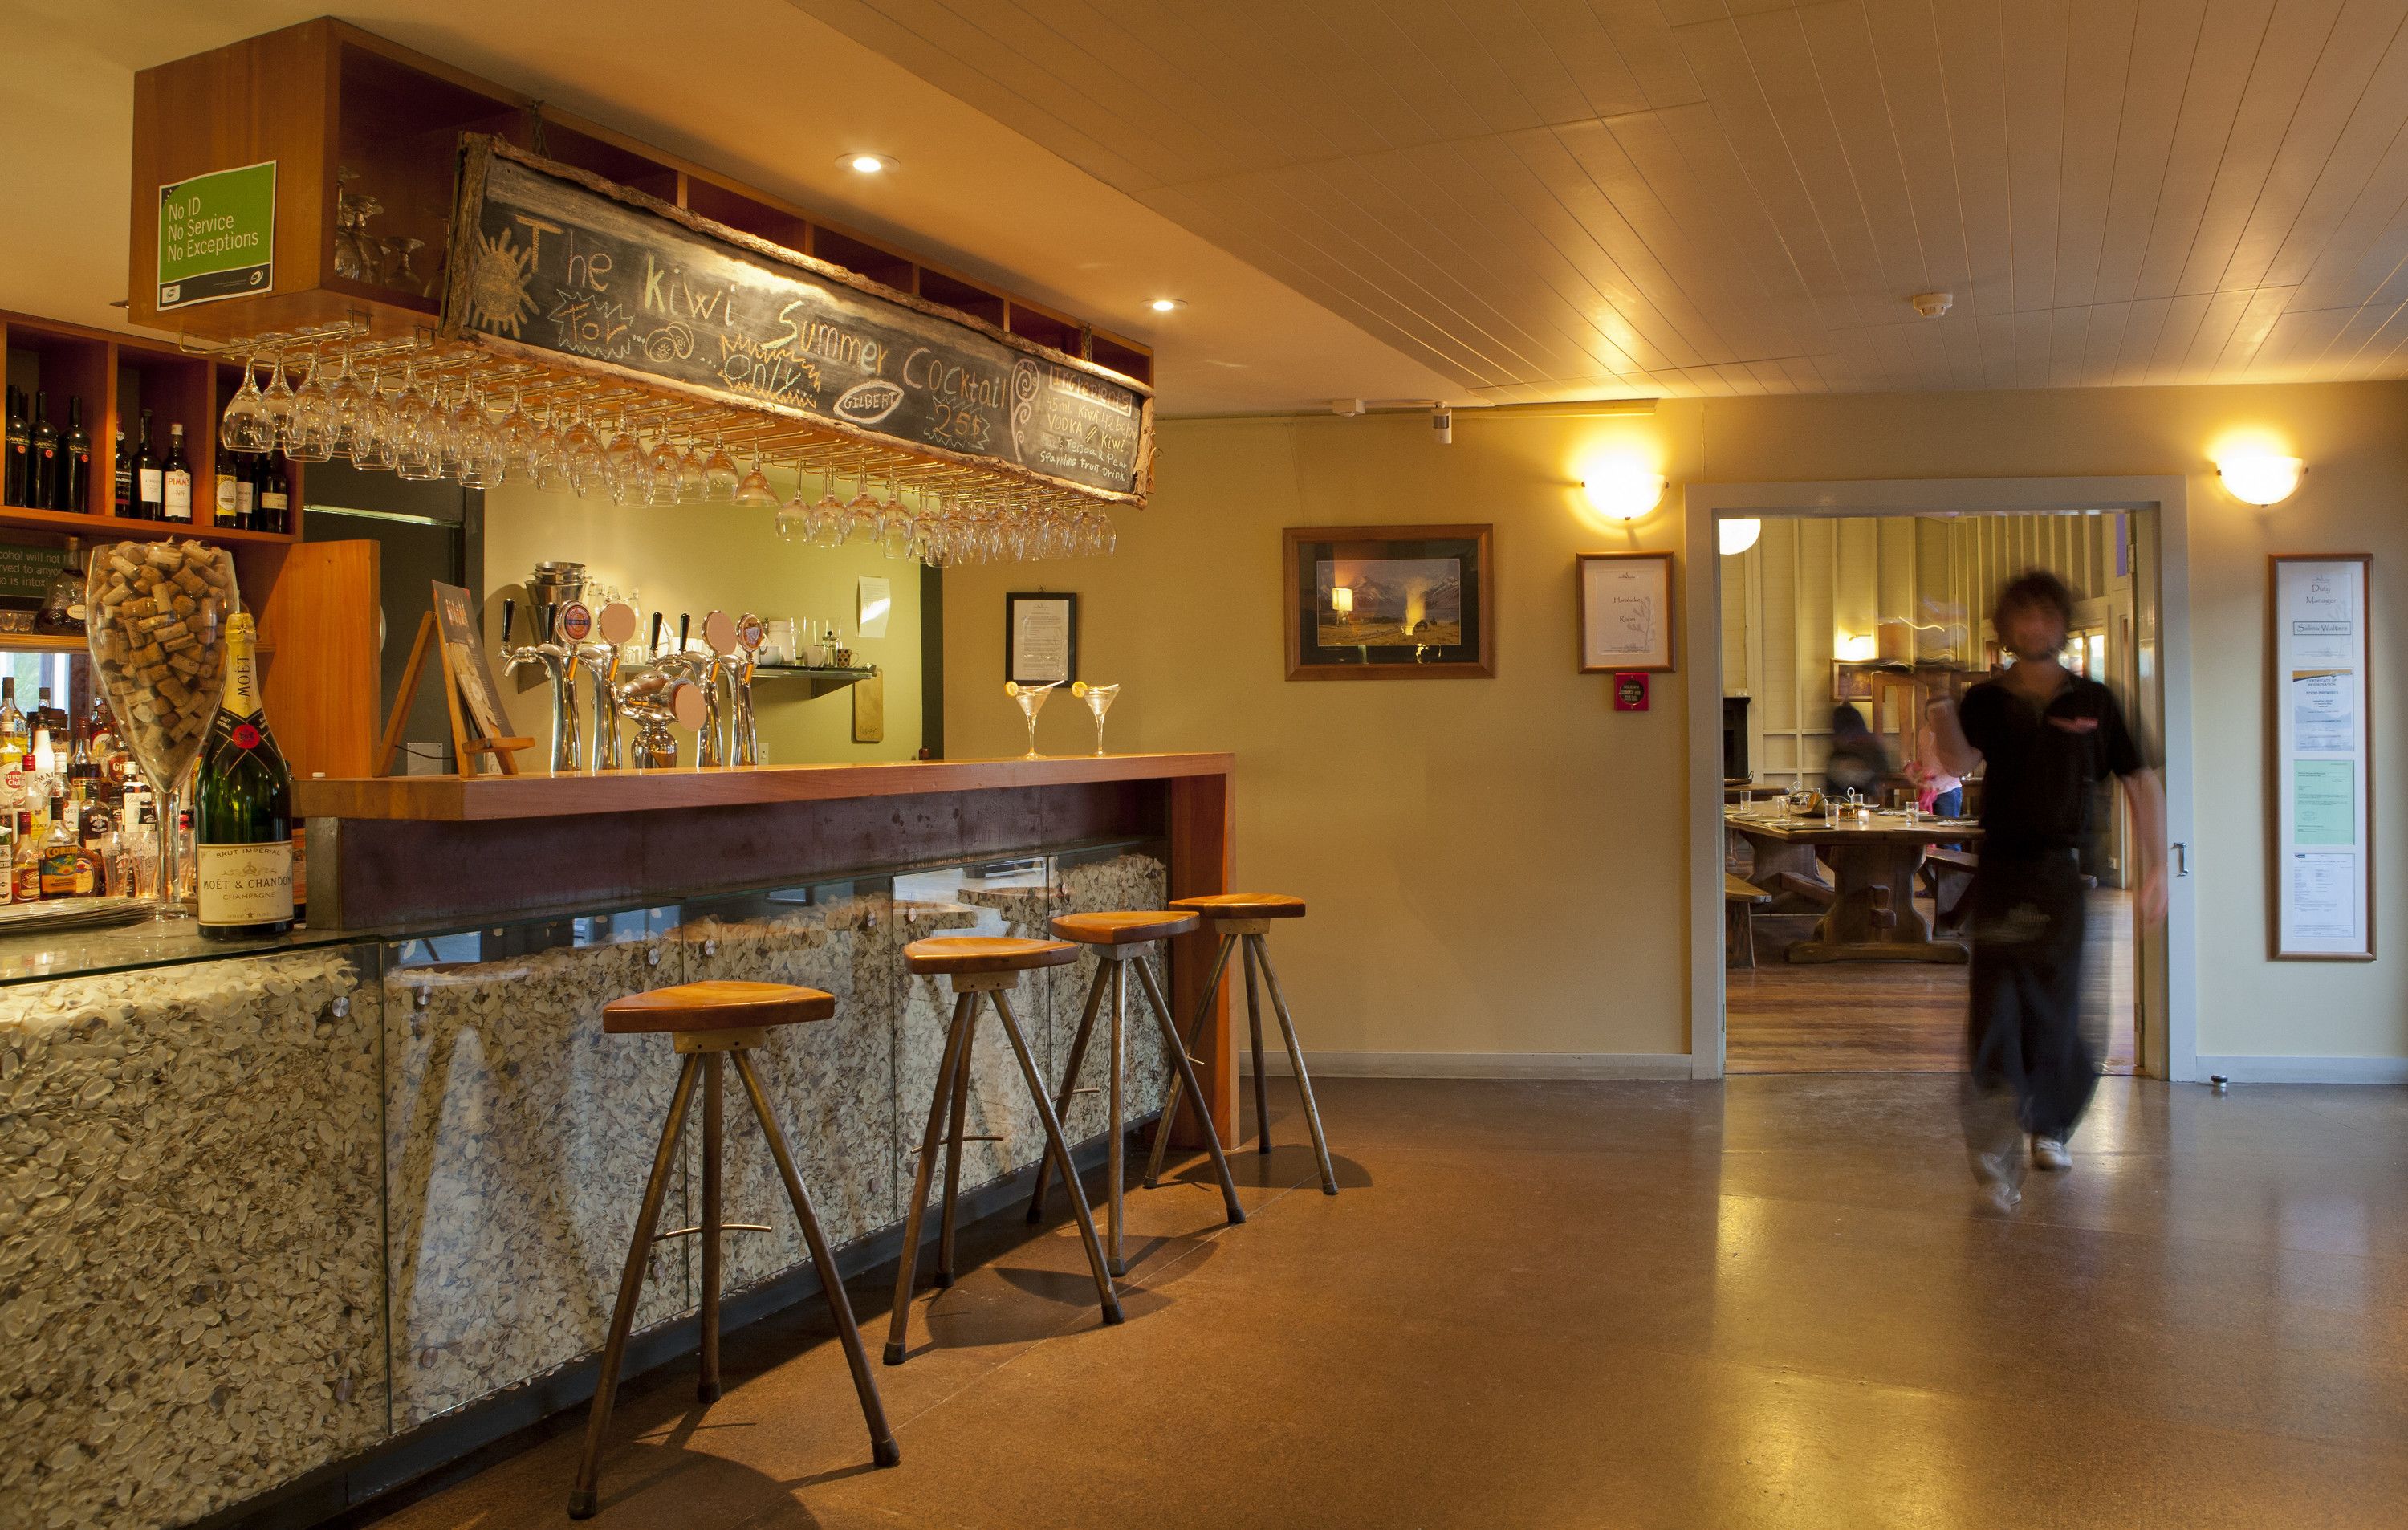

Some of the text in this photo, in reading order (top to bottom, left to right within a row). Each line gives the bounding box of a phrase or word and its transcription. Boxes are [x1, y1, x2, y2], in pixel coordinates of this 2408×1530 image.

[169, 197, 201, 222] No ID
[168, 214, 234, 242] No Service
[167, 231, 258, 262] No Exceptions
[515, 214, 612, 292] The
[761, 299, 888, 376] Summer
[902, 347, 1007, 409] Cocktail
[559, 302, 628, 344] For
[724, 354, 801, 396] Only
[844, 392, 898, 409] GILBERT
[1047, 413, 1083, 437] VODKA
[1101, 431, 1126, 452] Kiwi
[26, 551, 43, 562] will
[47, 555, 60, 564] not
[23, 565, 33, 574] to
[10, 576, 19, 586] is
[2312, 584, 2331, 594] Duty
[2306, 596, 2337, 605] Manager
[234, 655, 251, 698] MOËT
[216, 849, 238, 859] BRUT
[235, 880, 244, 889] &
[222, 891, 276, 901] CHAMPAGNE
